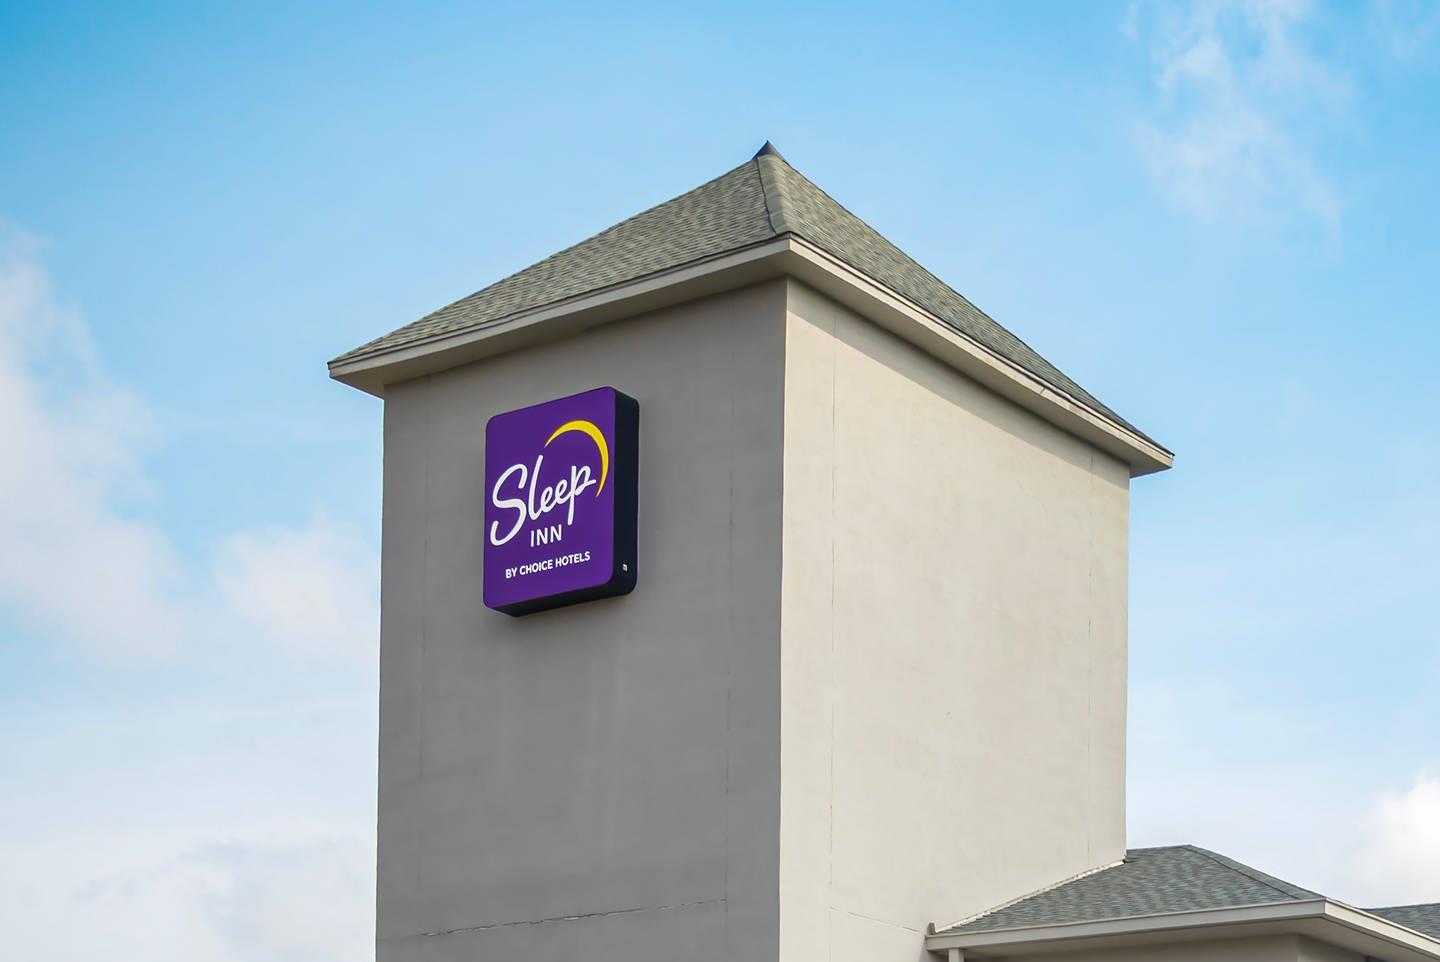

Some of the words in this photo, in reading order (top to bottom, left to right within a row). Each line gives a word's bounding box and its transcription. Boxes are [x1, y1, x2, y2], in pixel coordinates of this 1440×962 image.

[490, 454, 597, 546] Sleep
[530, 523, 563, 548] INN
[505, 567, 518, 579] BY
[519, 559, 554, 576] CHOICE
[555, 551, 591, 568] HOTELS
